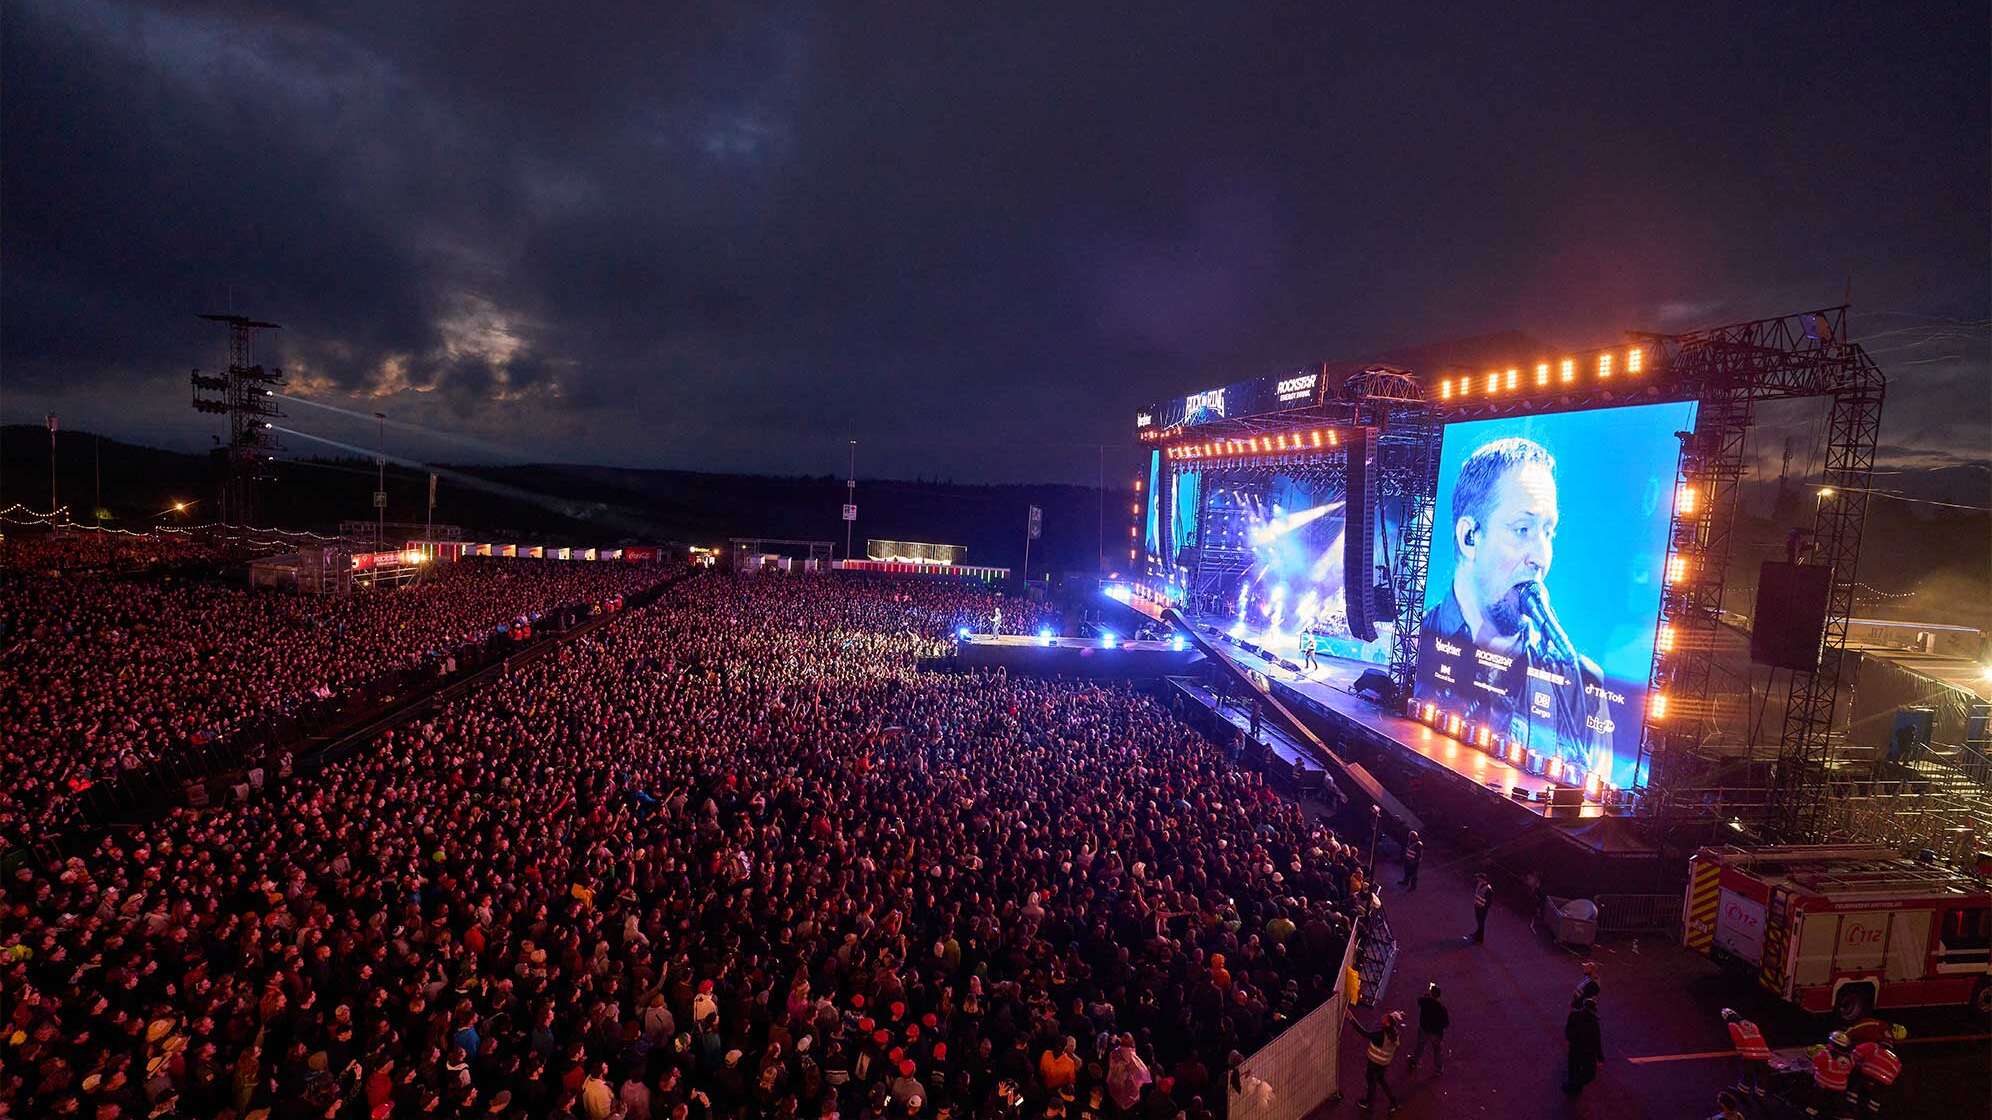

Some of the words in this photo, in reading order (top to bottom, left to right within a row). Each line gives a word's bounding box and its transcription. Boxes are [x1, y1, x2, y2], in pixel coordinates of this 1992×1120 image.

[1277, 374, 1316, 394] ROCKSTAR
[1475, 649, 1513, 667] ROCKSTAR
[1595, 687, 1624, 704] TikTok
[1531, 705, 1550, 718] Cargo
[1861, 927, 1882, 942] 112
